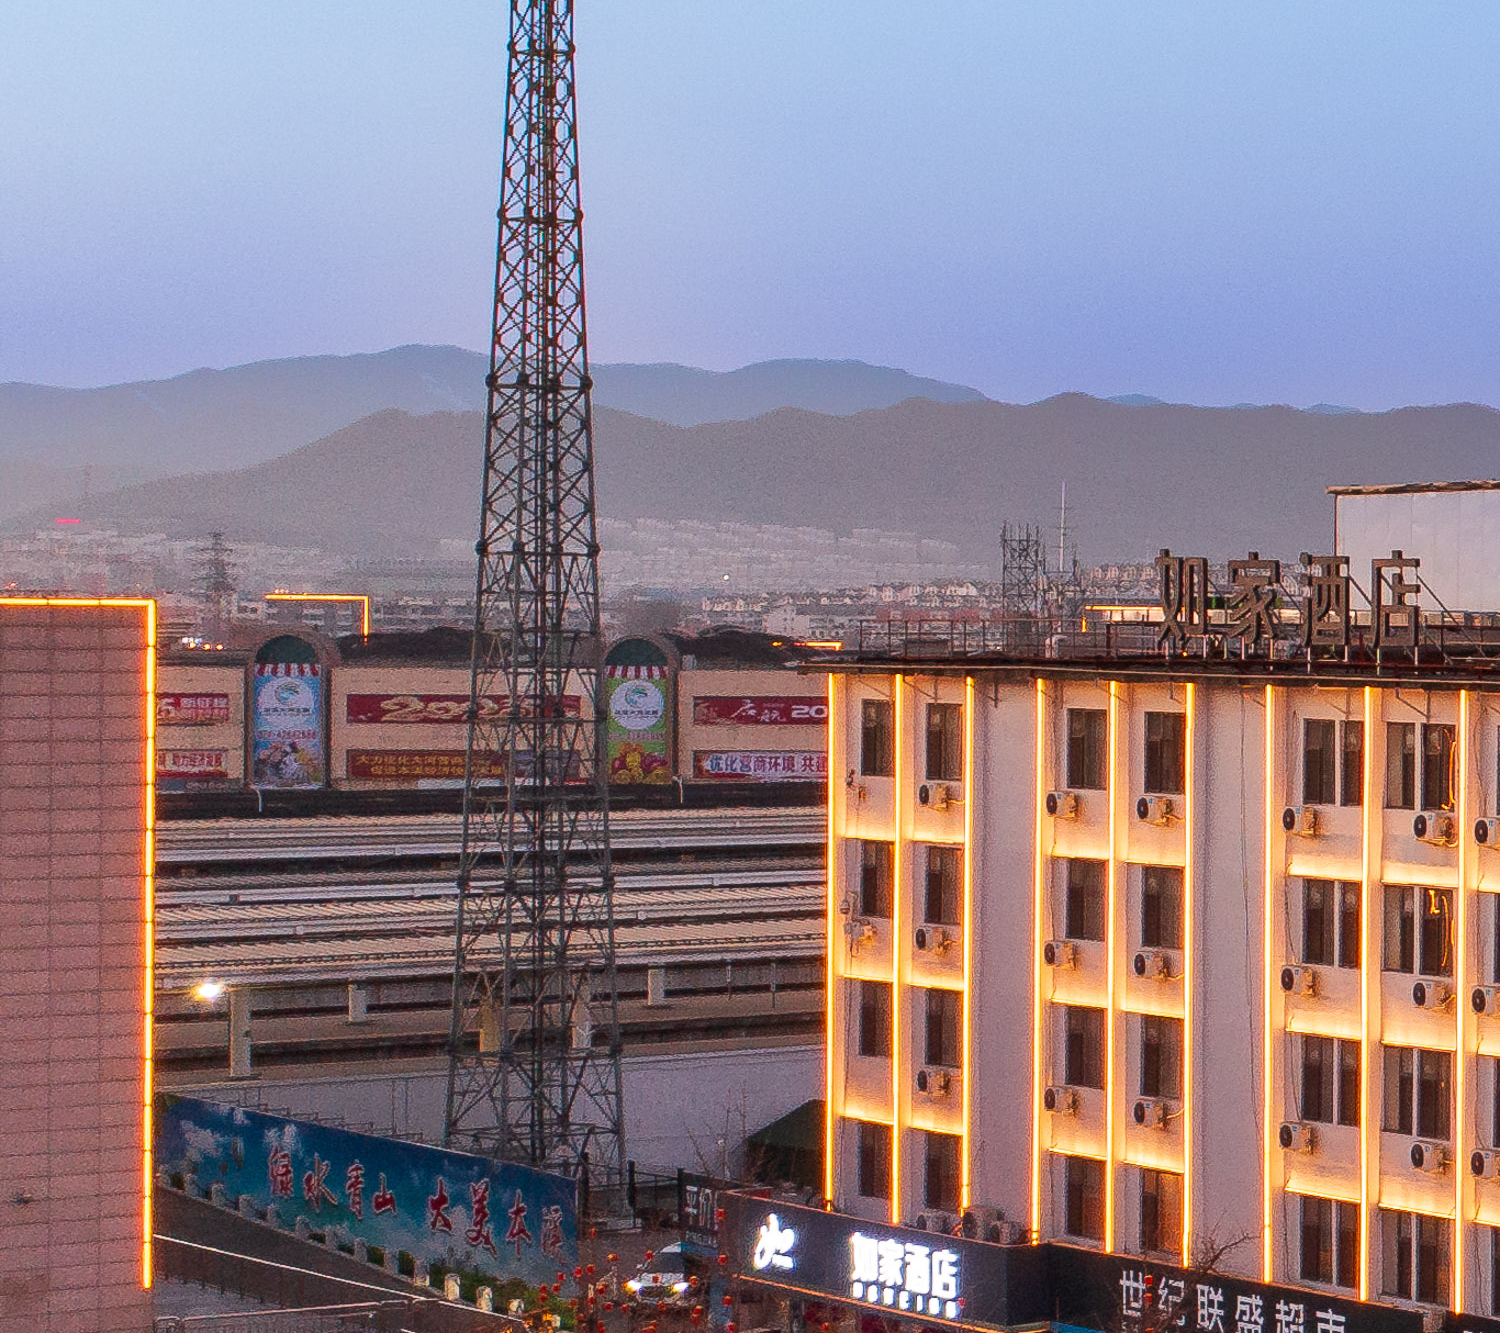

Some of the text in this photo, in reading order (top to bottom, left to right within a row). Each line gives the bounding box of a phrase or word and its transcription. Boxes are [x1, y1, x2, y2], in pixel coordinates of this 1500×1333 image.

[1155, 548, 1422, 647] 如家酒店
[709, 754, 796, 774] 优化营商环境
[267, 1143, 567, 1265] 绿水青山 大美本溪
[850, 1231, 960, 1300] 如家酒店
